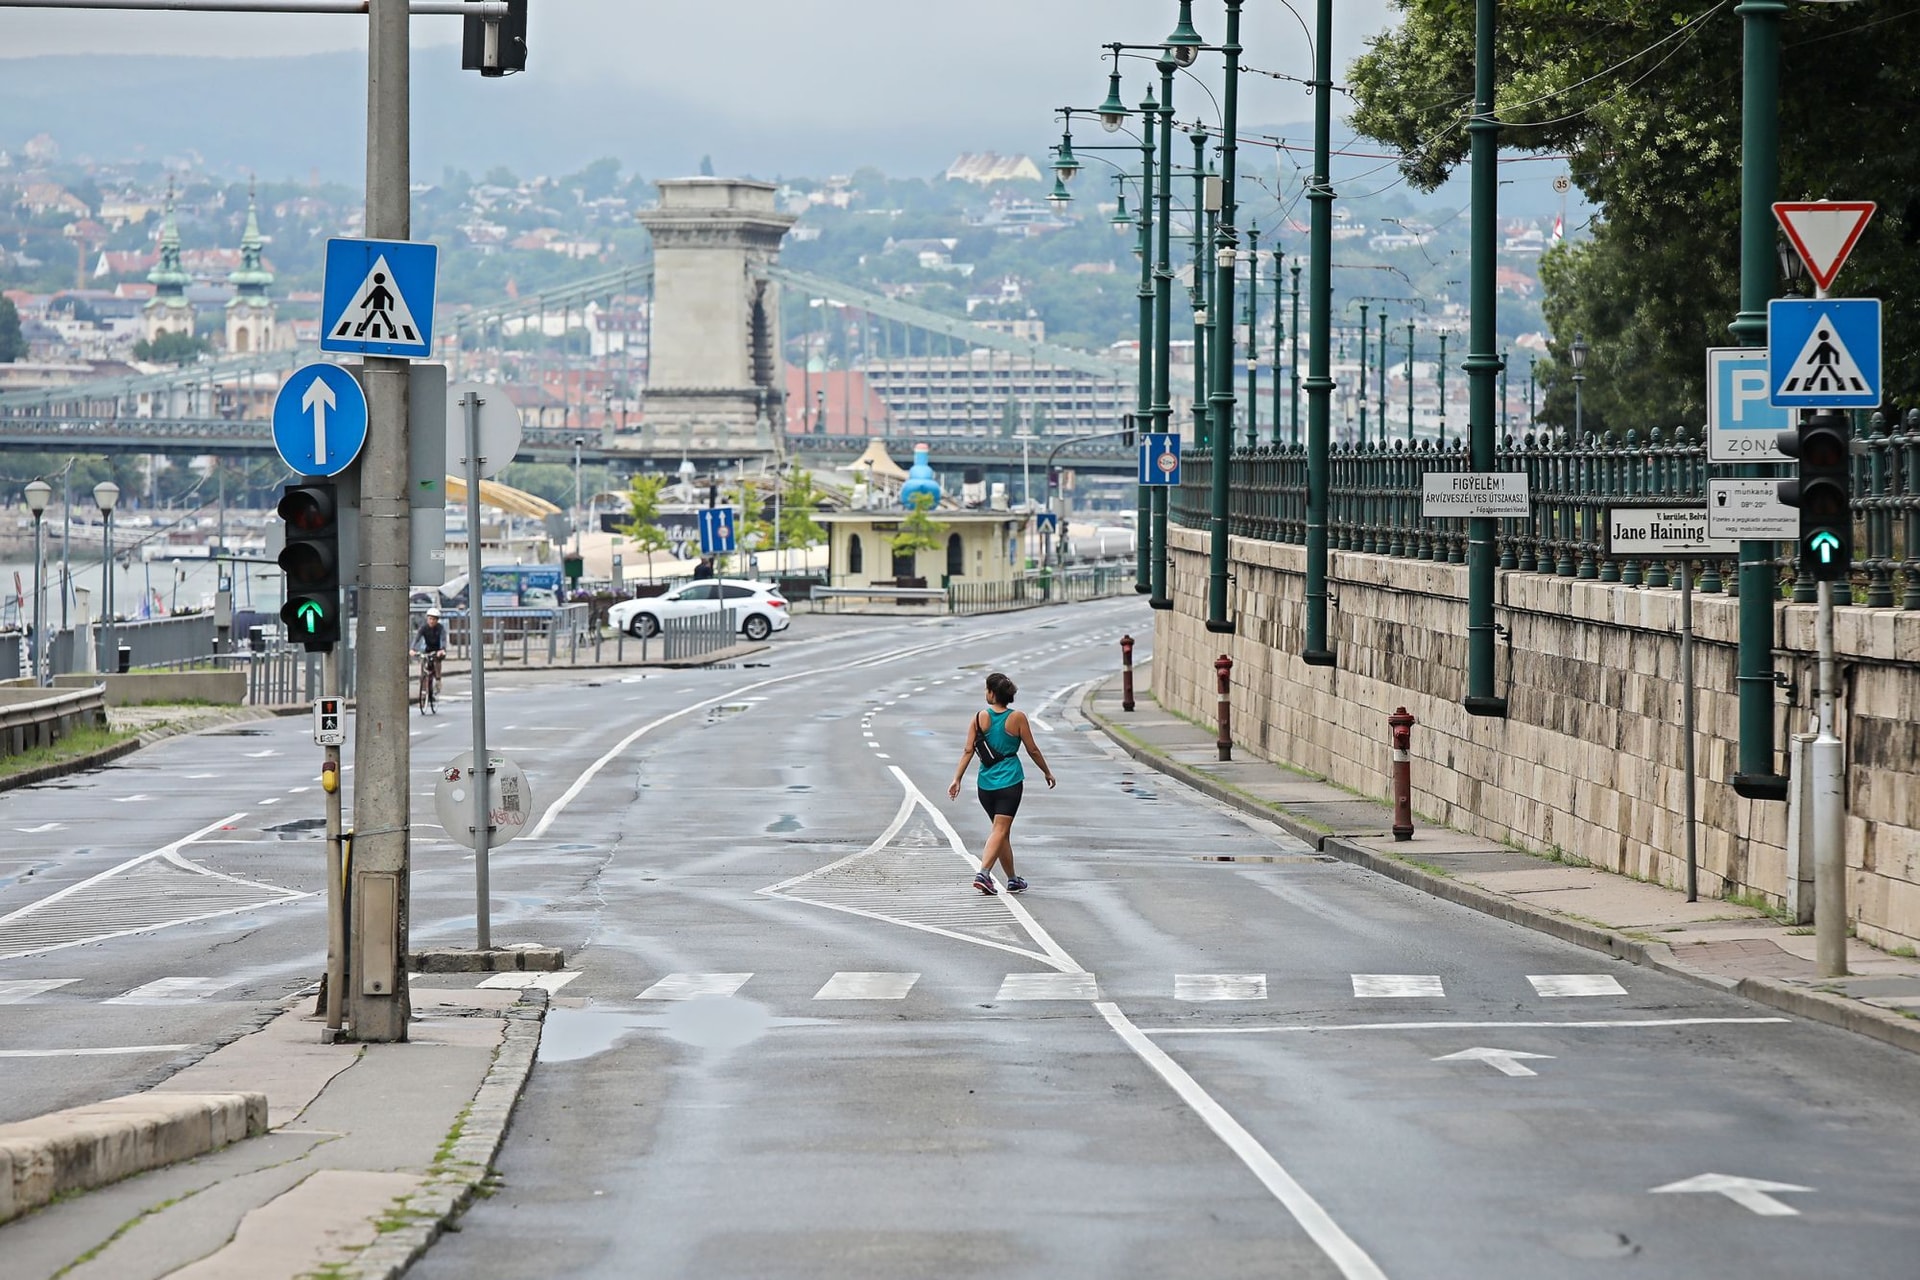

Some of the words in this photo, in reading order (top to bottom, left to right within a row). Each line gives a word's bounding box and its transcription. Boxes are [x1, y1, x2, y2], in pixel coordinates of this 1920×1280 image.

[1557, 181, 1567, 189] 35
[1731, 369, 1768, 421] P
[1728, 435, 1779, 452] ZÓNA
[1425, 492, 1487, 503] ÁRVÍZVESZÉLYES
[1734, 488, 1774, 496] munkanap
[1656, 512, 1662, 521] V.
[1662, 512, 1689, 522] kerület,
[1689, 512, 1707, 521] Belvá
[1612, 523, 1647, 540] Jane
[1650, 522, 1705, 543] Haining
